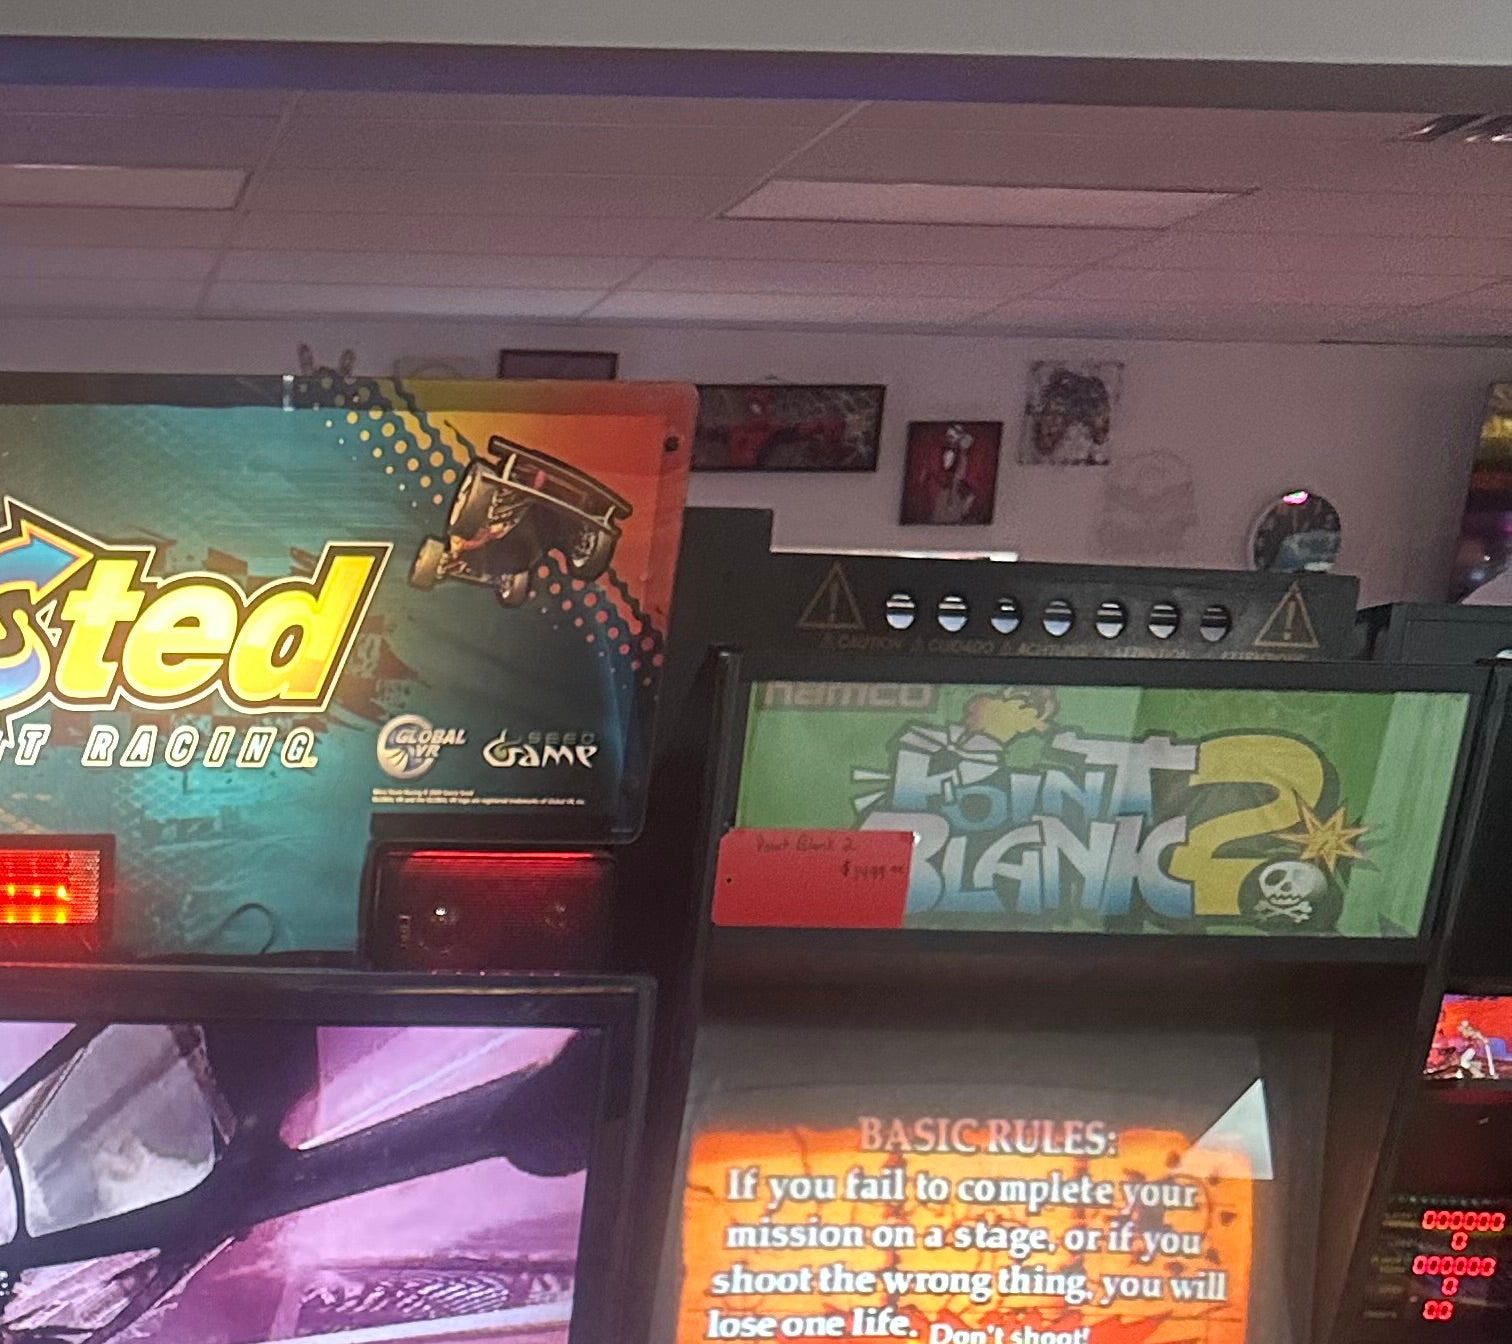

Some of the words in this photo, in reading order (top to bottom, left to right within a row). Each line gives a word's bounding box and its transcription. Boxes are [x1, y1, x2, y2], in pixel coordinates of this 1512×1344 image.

[83, 723, 318, 769] RACING
[396, 729, 467, 745] GLOBAL
[415, 745, 441, 758] VR
[1169, 733, 1325, 916] 2
[858, 1116, 979, 1152] BASIC
[987, 1119, 1118, 1157] RULES:
[728, 1168, 759, 1200] If
[769, 1175, 837, 1210] you
[846, 1167, 905, 1201] fail
[916, 1172, 950, 1201] to
[957, 1172, 1114, 1213] complete
[1122, 1181, 1199, 1215] your
[726, 1216, 865, 1248] mission
[872, 1226, 916, 1248] on
[924, 1226, 945, 1249] a
[954, 1222, 1056, 1259] stage,
[1064, 1229, 1103, 1251] or
[1108, 1221, 1136, 1251] if
[1143, 1231, 1202, 1263] you
[711, 1264, 812, 1295] shoot
[819, 1264, 877, 1294] the
[882, 1271, 993, 1303] wrong
[998, 1265, 1094, 1304] thing,
[1100, 1275, 1163, 1305] you
[1170, 1271, 1228, 1301] will
[707, 1309, 777, 1339] lose
[781, 1315, 846, 1338] one
[852, 1306, 919, 1338] life.
